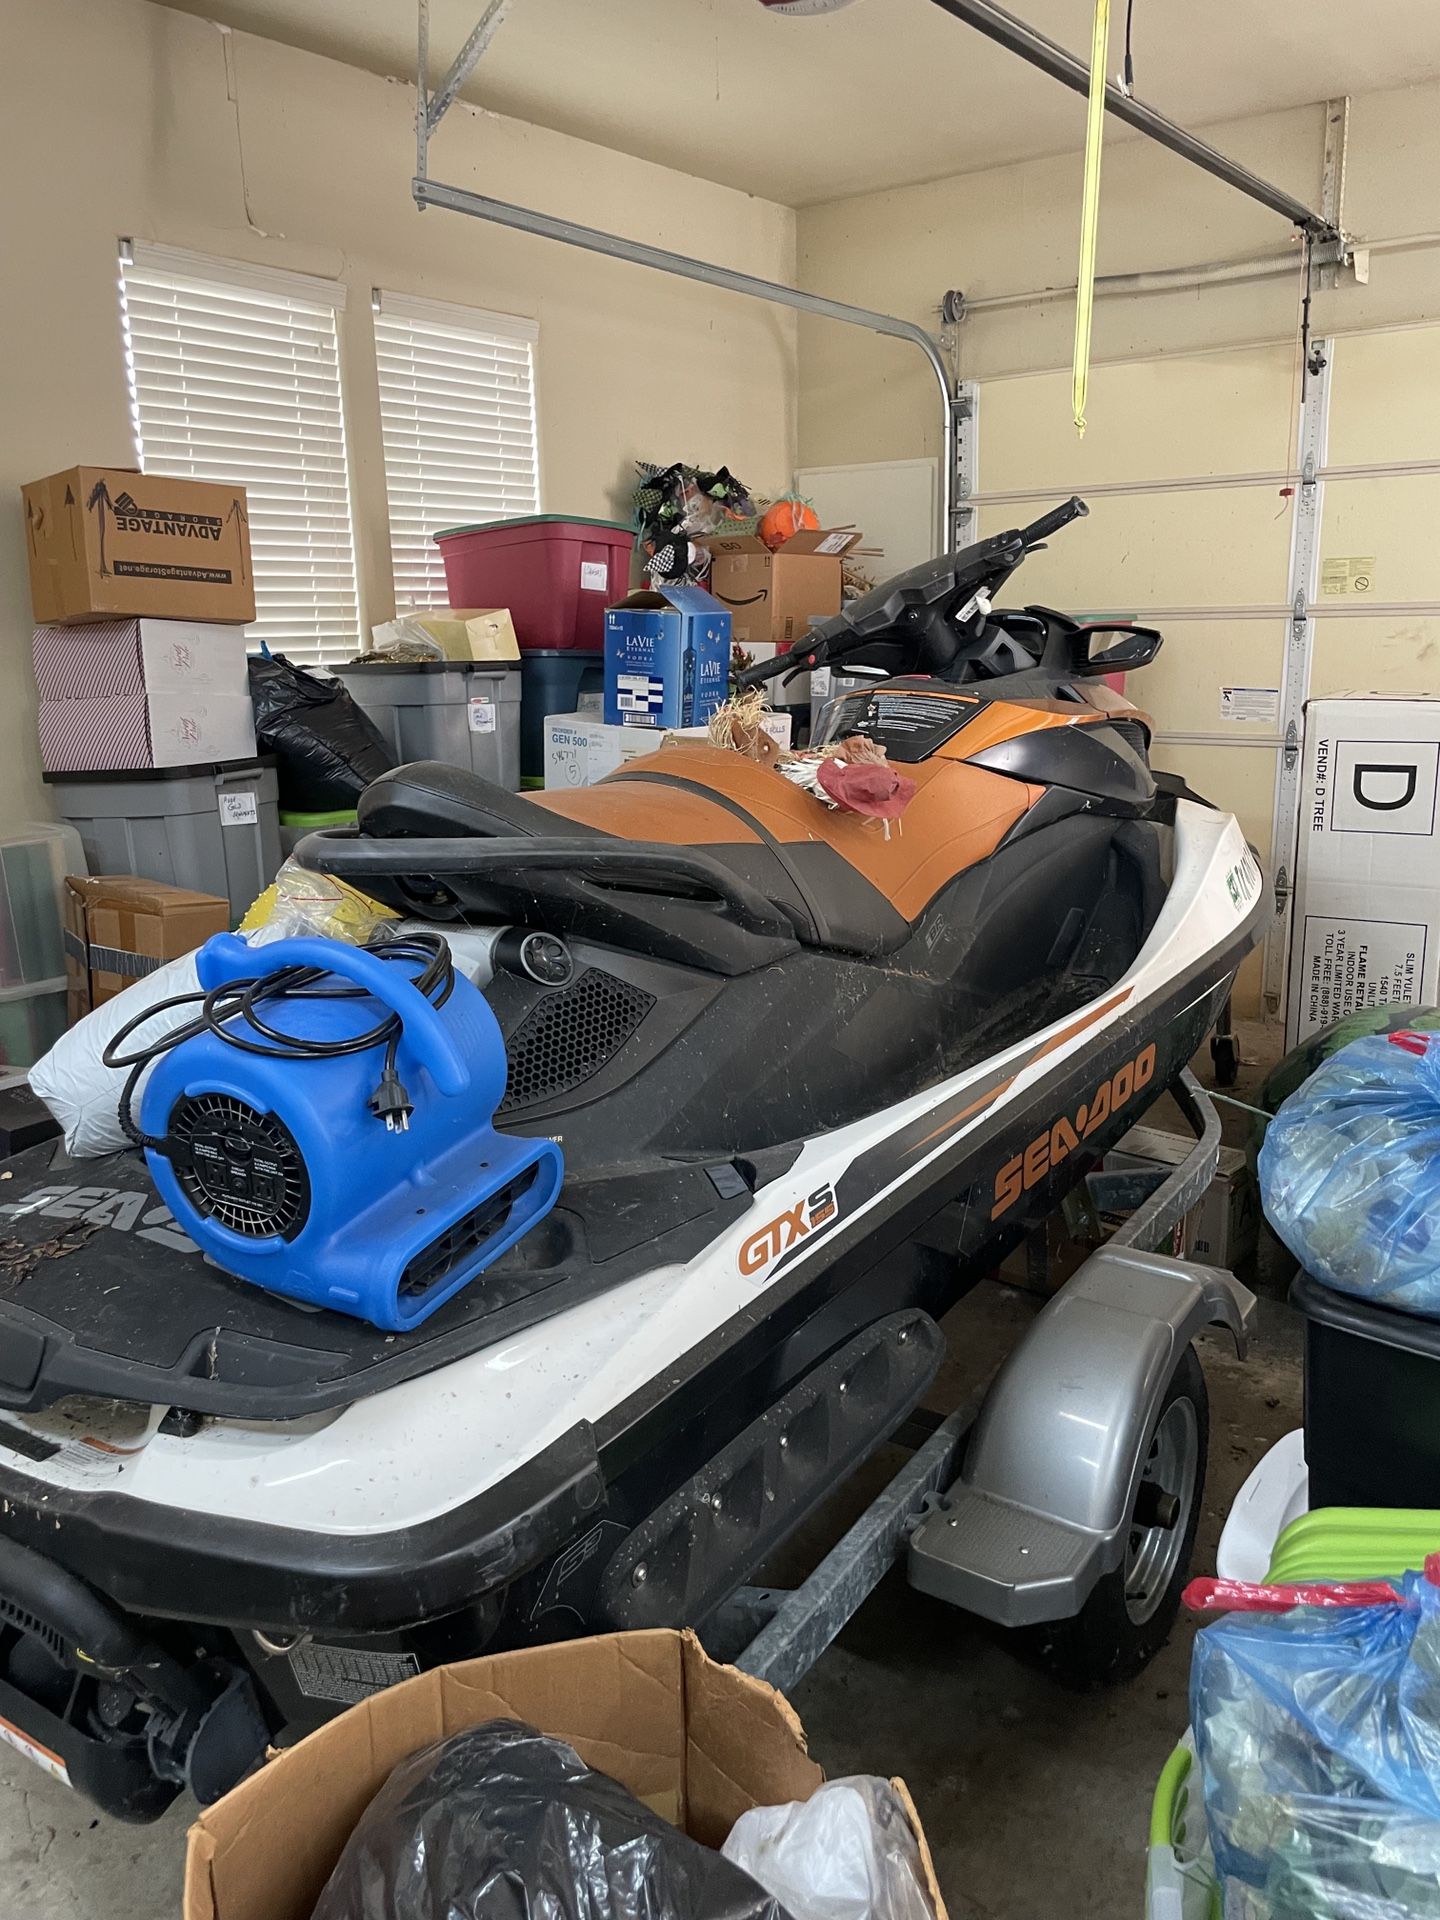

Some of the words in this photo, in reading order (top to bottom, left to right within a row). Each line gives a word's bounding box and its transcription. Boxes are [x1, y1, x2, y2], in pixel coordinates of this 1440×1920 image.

[116, 516, 222, 541] ADVANTAGE
[141, 511, 222, 526] STORAGE
[119, 565, 227, 579] www.AdvantageStorage.net
[552, 733, 570, 745] GEN
[572, 737, 588, 747] 500
[1316, 739, 1329, 784] VEND#:
[1315, 787, 1326, 796] D
[1353, 764, 1418, 811] D
[1312, 799, 1325, 832] TREE
[1324, 933, 1334, 956] TOLL
[1335, 937, 1346, 962] YEAR
[1311, 955, 1321, 981] MADE
[1345, 951, 1356, 987] INDOOR
[1358, 945, 1368, 979] FLAME
[1394, 964, 1404, 977] 7.5
[1405, 952, 1415, 975] SLIM
[1311, 983, 1319, 992] IN
[1333, 964, 1343, 999] LIMITED
[1380, 975, 1389, 996] 1540
[1309, 993, 1319, 1022] CHINA
[1343, 988, 1353, 1007] USE
[739, 1199, 810, 1276] GTX
